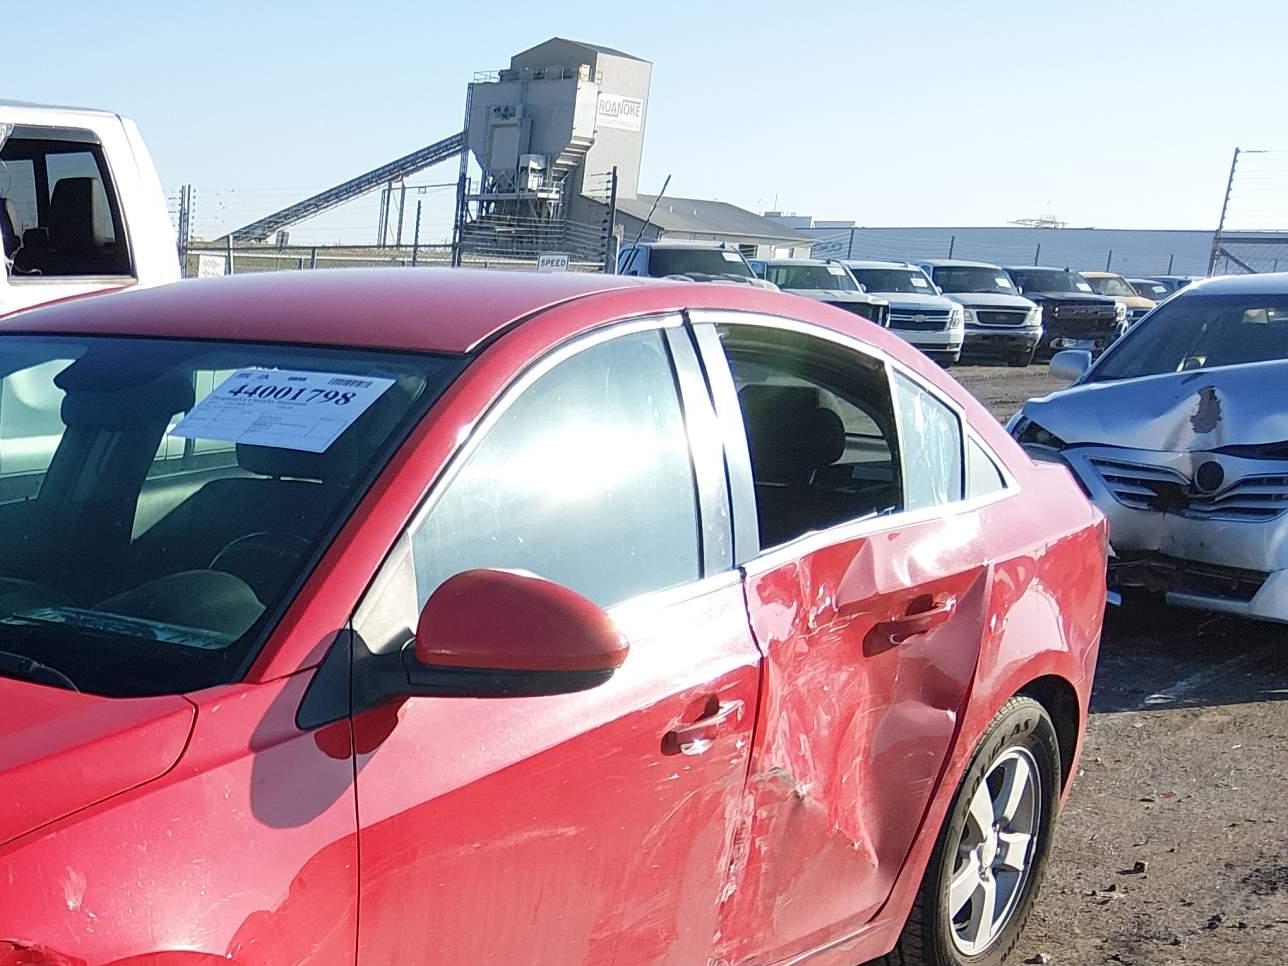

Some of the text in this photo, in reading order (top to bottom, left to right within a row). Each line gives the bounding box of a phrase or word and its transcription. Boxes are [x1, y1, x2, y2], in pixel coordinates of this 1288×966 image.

[599, 99, 641, 117] ROANOKE
[541, 259, 566, 267] SPEED
[228, 384, 357, 406] 44001798
